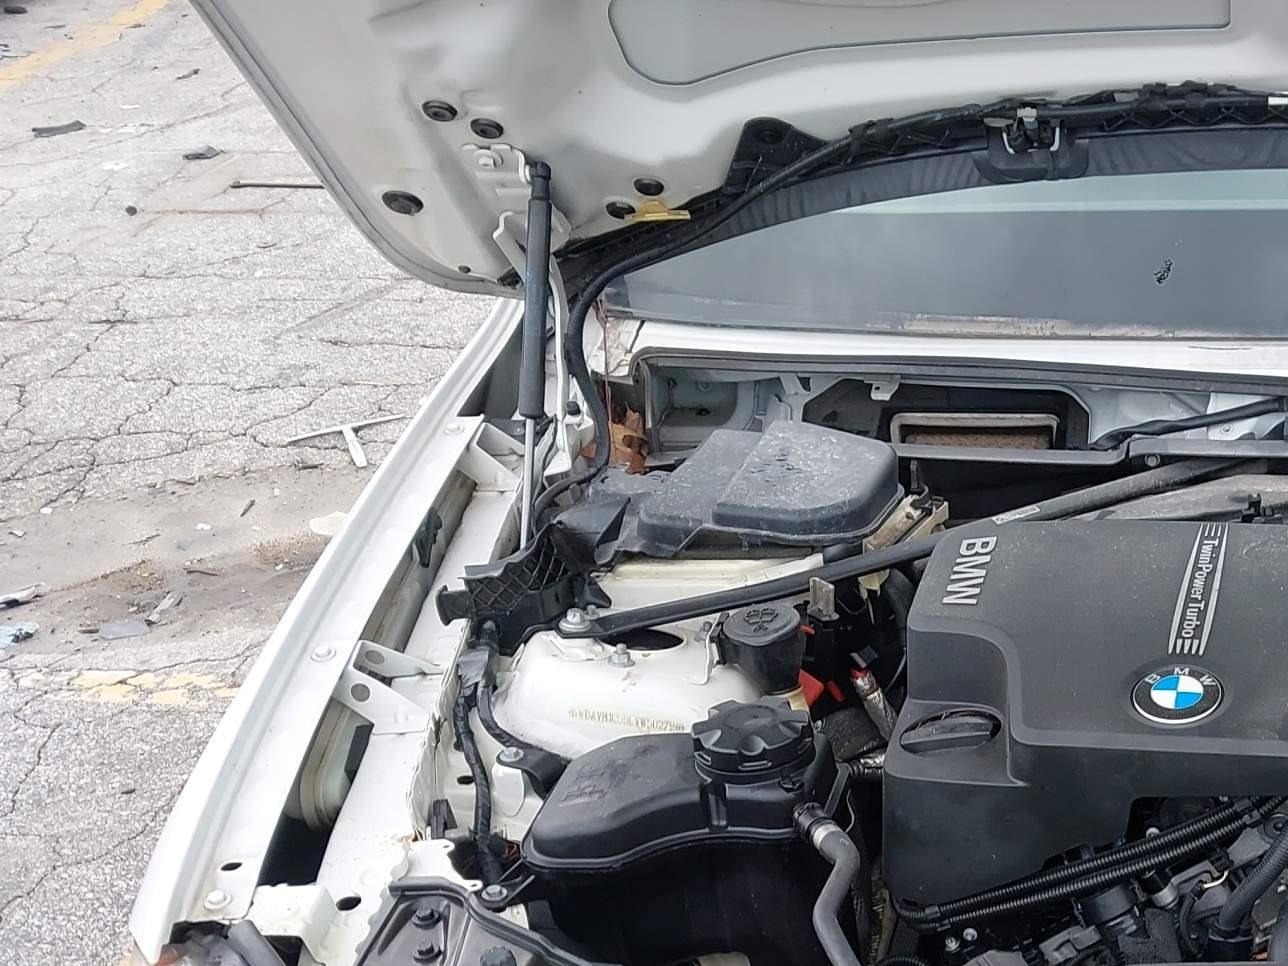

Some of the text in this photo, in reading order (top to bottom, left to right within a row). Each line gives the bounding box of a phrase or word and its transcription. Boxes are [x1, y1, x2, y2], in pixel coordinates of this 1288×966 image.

[942, 536, 998, 605] BMW
[1181, 538, 1219, 638] TwinPower Turbo
[1144, 666, 1217, 686] BMW
